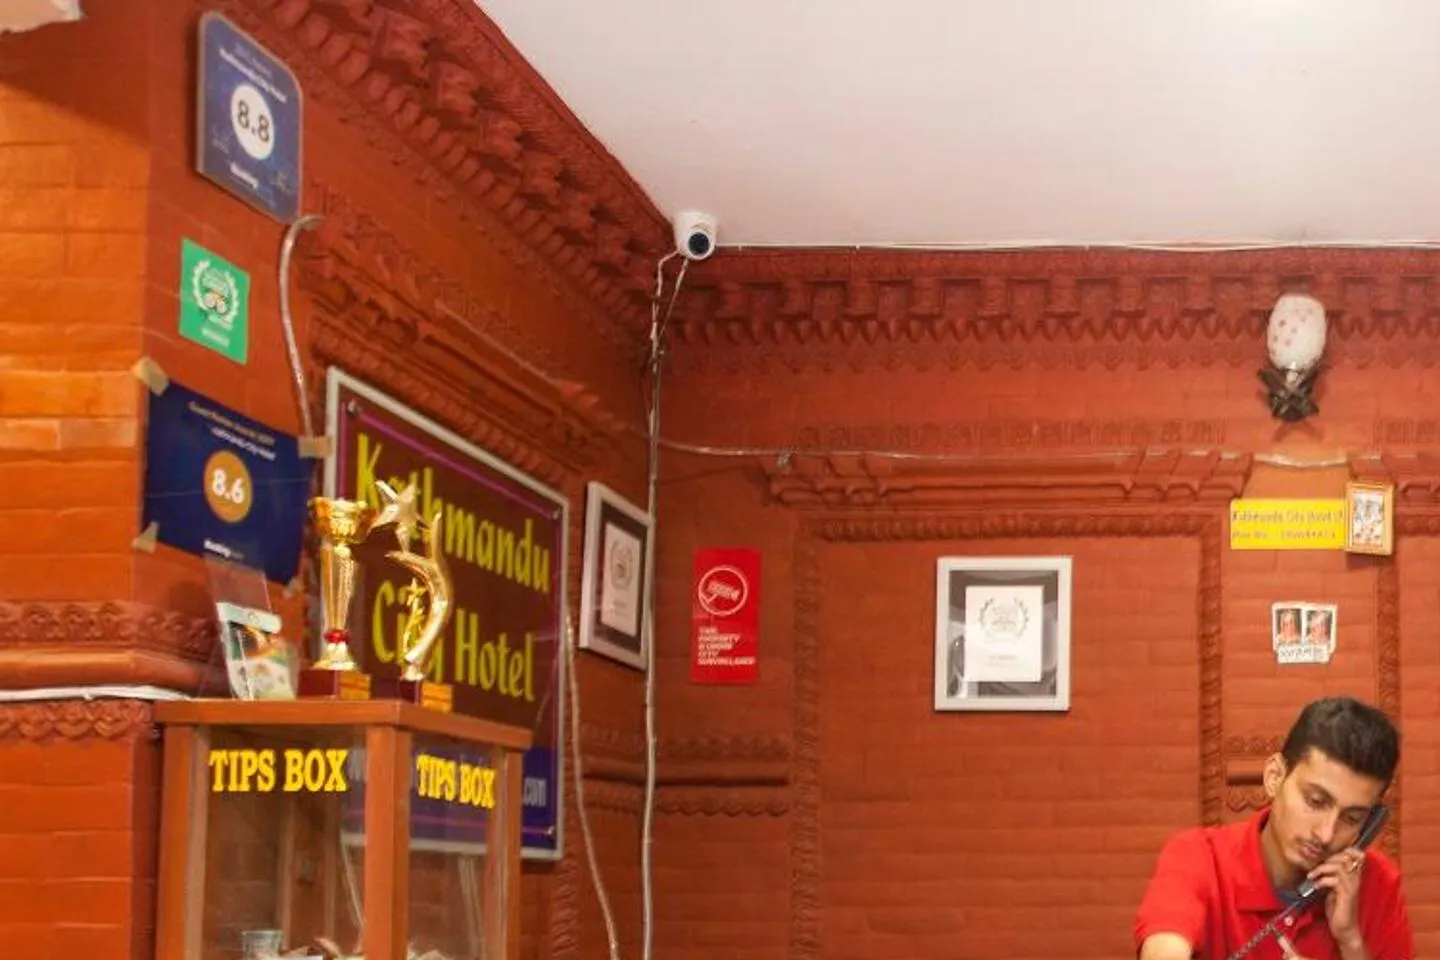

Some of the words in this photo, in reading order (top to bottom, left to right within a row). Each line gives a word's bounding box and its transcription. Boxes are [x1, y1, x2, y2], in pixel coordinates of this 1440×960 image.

[237, 100, 270, 142] 8.8
[212, 467, 245, 504] 8.6
[456, 606, 536, 702] Hotel
[208, 749, 276, 792] TIPS
[283, 749, 348, 792] BOX
[416, 753, 456, 802] TIPS
[459, 763, 496, 809] BOX
